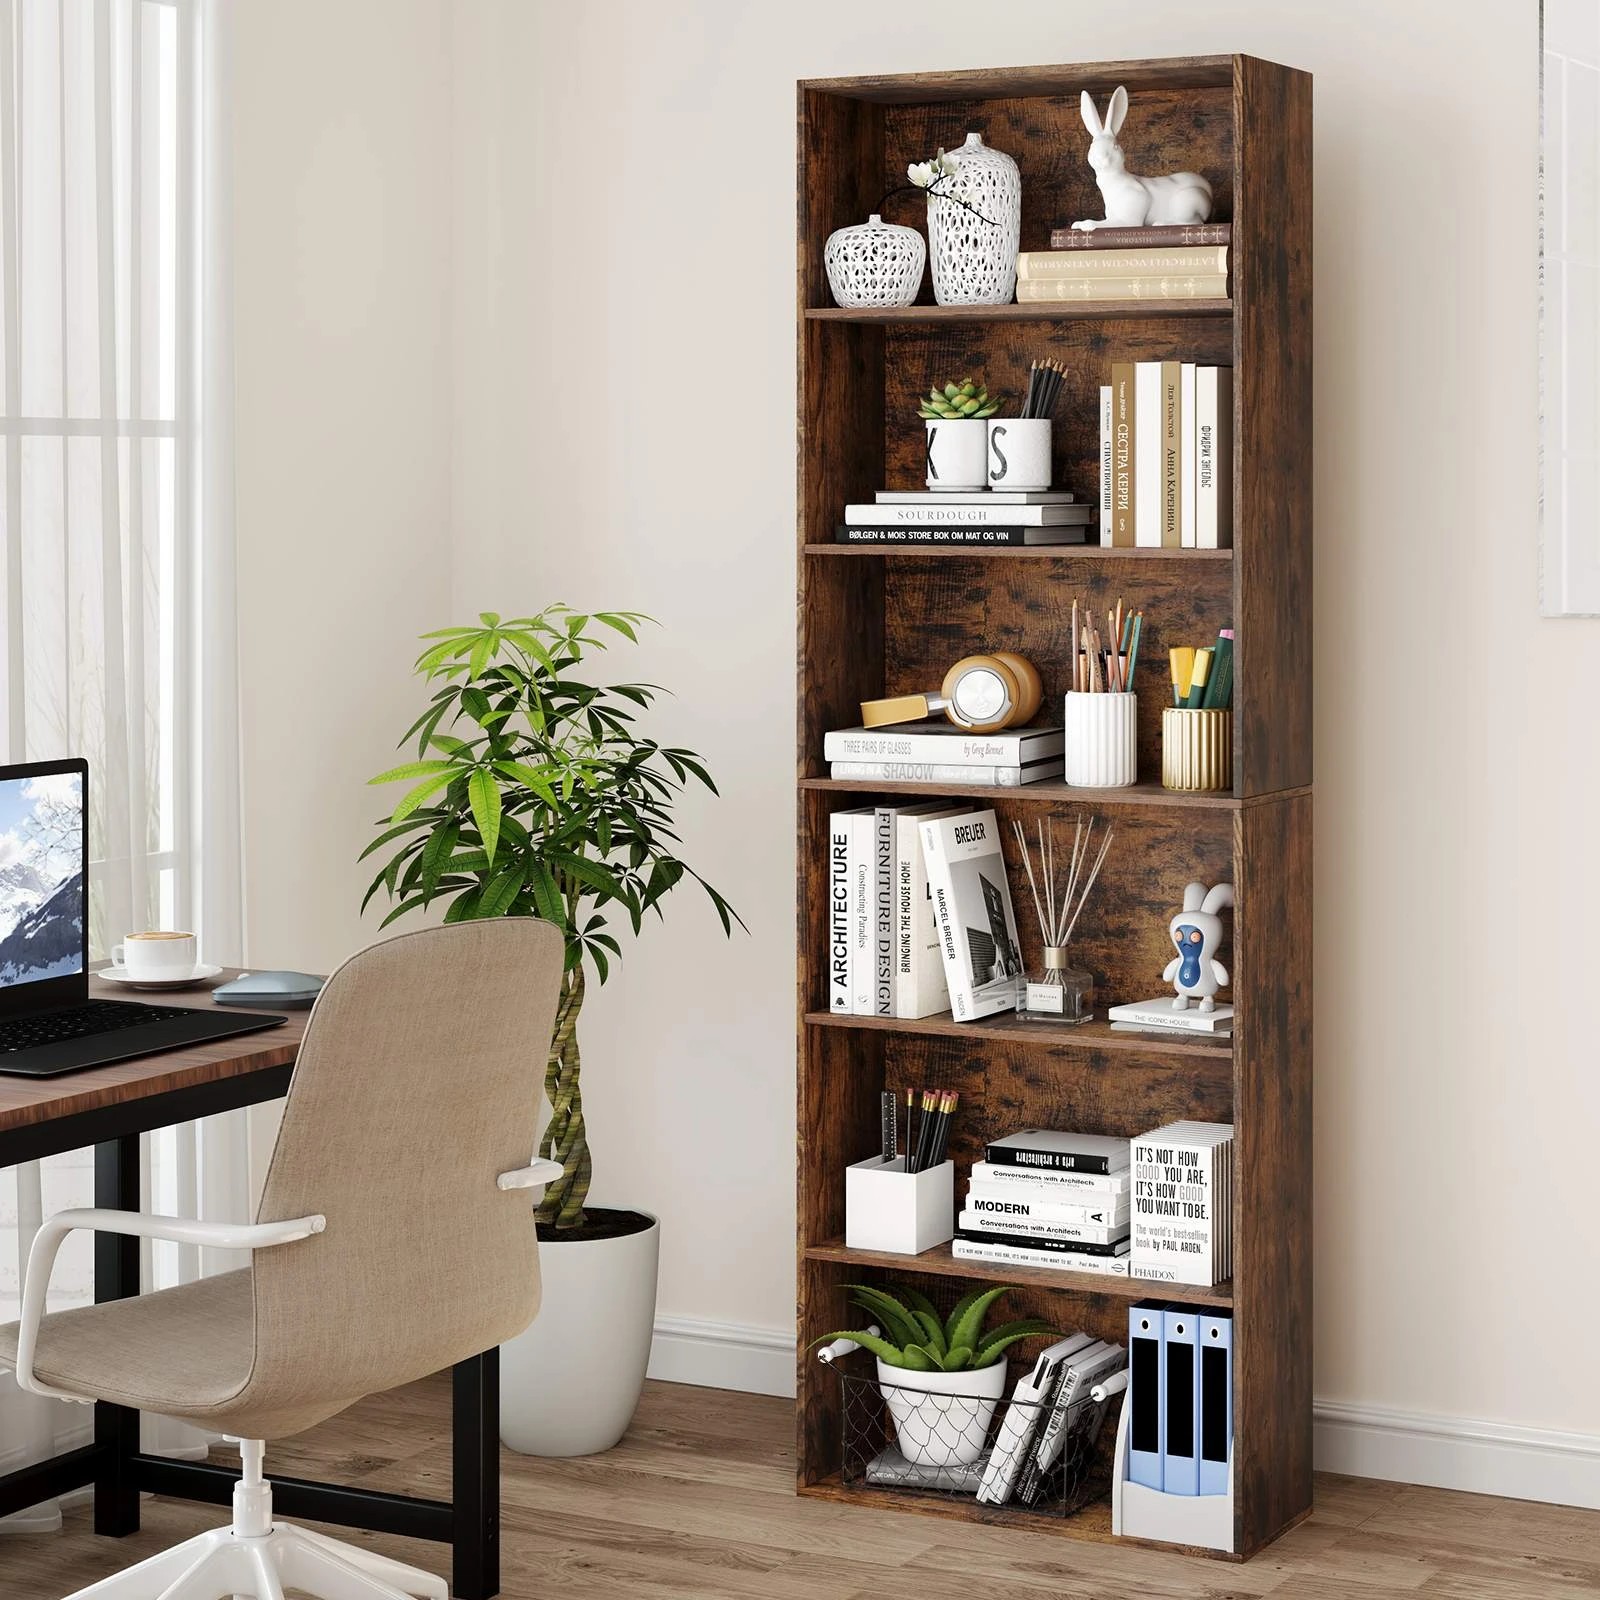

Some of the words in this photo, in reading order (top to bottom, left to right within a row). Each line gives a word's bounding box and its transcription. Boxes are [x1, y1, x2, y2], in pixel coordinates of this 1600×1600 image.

[1102, 258, 1147, 268] VOCUM
[990, 426, 1008, 481] S
[1117, 423, 1129, 469] СЕСТРА
[1167, 448, 1175, 477] АННА
[1117, 472, 1129, 510] КЕРРИ
[897, 510, 988, 521] SOURDOUGH
[1167, 479, 1175, 532] КАРЕНИНА
[849, 531, 878, 540] BØLGEN
[880, 531, 886, 540] &
[887, 531, 906, 540] MOIS
[908, 531, 932, 540] STORE
[934, 531, 949, 540] BOK
[951, 531, 964, 540] OM
[965, 531, 981, 540] MAT
[983, 531, 995, 540] OG
[996, 531, 1009, 540] VIN
[843, 740, 861, 753] THREE
[862, 741, 877, 754] PAIRS
[879, 741, 886, 754] OF
[887, 741, 912, 755] GLASSES
[963, 743, 970, 758] by
[883, 764, 934, 780] SHADOW
[954, 822, 986, 845] BREUER
[878, 812, 891, 932] FURNITURE
[901, 861, 910, 883] HOME
[857, 864, 867, 915] Constructing
[901, 884, 910, 912] HOUSE
[833, 833, 847, 987] ARCHITECTURE
[901, 913, 910, 930] THE
[937, 888, 949, 924] MARCEL
[943, 925, 956, 960] BREUER
[901, 931, 910, 973] BRINGING
[878, 939, 891, 1015] DESIGN
[1136, 1146, 1153, 1163] IT'S
[1156, 1148, 1174, 1165] NOT
[1178, 1150, 1199, 1167] HOW
[993, 1170, 1042, 1181] Conversations
[1043, 1175, 1058, 1183] with
[1060, 1176, 1095, 1186] Architects
[1136, 1164, 1160, 1181] GOOD
[1164, 1166, 1182, 1183] YOU
[1186, 1168, 1208, 1188] ARE,
[1136, 1181, 1153, 1197] IT'S
[1156, 1182, 1176, 1199] HOW
[1179, 1185, 1203, 1202] GOOD
[974, 1200, 1030, 1216] MODERN
[1091, 1213, 1103, 1223] A
[1136, 1198, 1154, 1215] YOU
[1155, 1199, 1181, 1217] WANT
[980, 1219, 1029, 1231] Conversations
[1030, 1224, 1045, 1232] with
[1046, 1226, 1082, 1237] Architects
[1136, 1223, 1146, 1235] The
[1148, 1225, 1172, 1238] world's
[1136, 1237, 1150, 1249] book
[1152, 1239, 1160, 1251] by
[1162, 1239, 1178, 1252] PAUL
[1180, 1241, 1203, 1254] ARDEN.
[1134, 1267, 1176, 1281] PHAIDON
